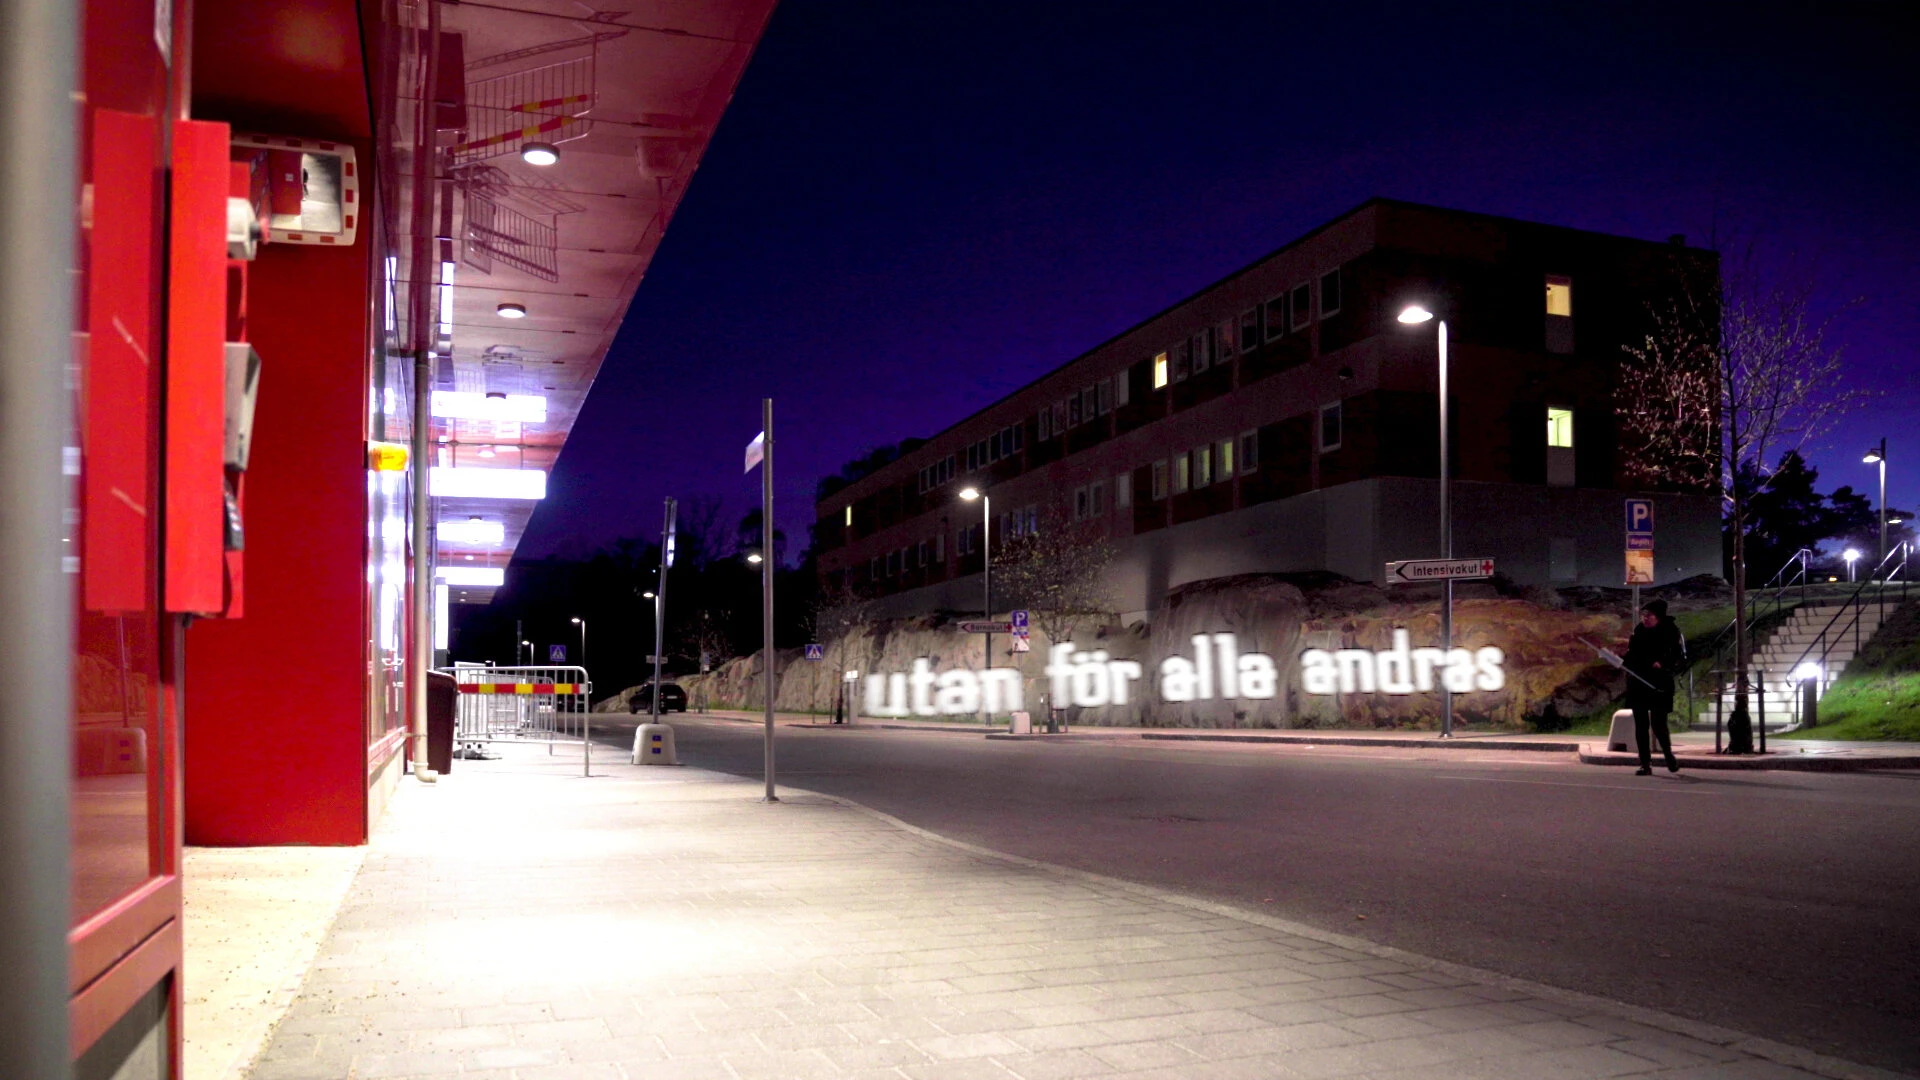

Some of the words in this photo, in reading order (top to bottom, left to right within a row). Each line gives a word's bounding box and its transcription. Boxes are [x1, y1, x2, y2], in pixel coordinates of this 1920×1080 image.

[1632, 502, 1649, 530] P
[1413, 563, 1478, 577] Intensivakut
[1016, 612, 1026, 626] P
[864, 655, 1022, 716] utan
[1045, 640, 1143, 710] för
[1160, 632, 1278, 702] alla
[1300, 627, 1506, 695] andras
